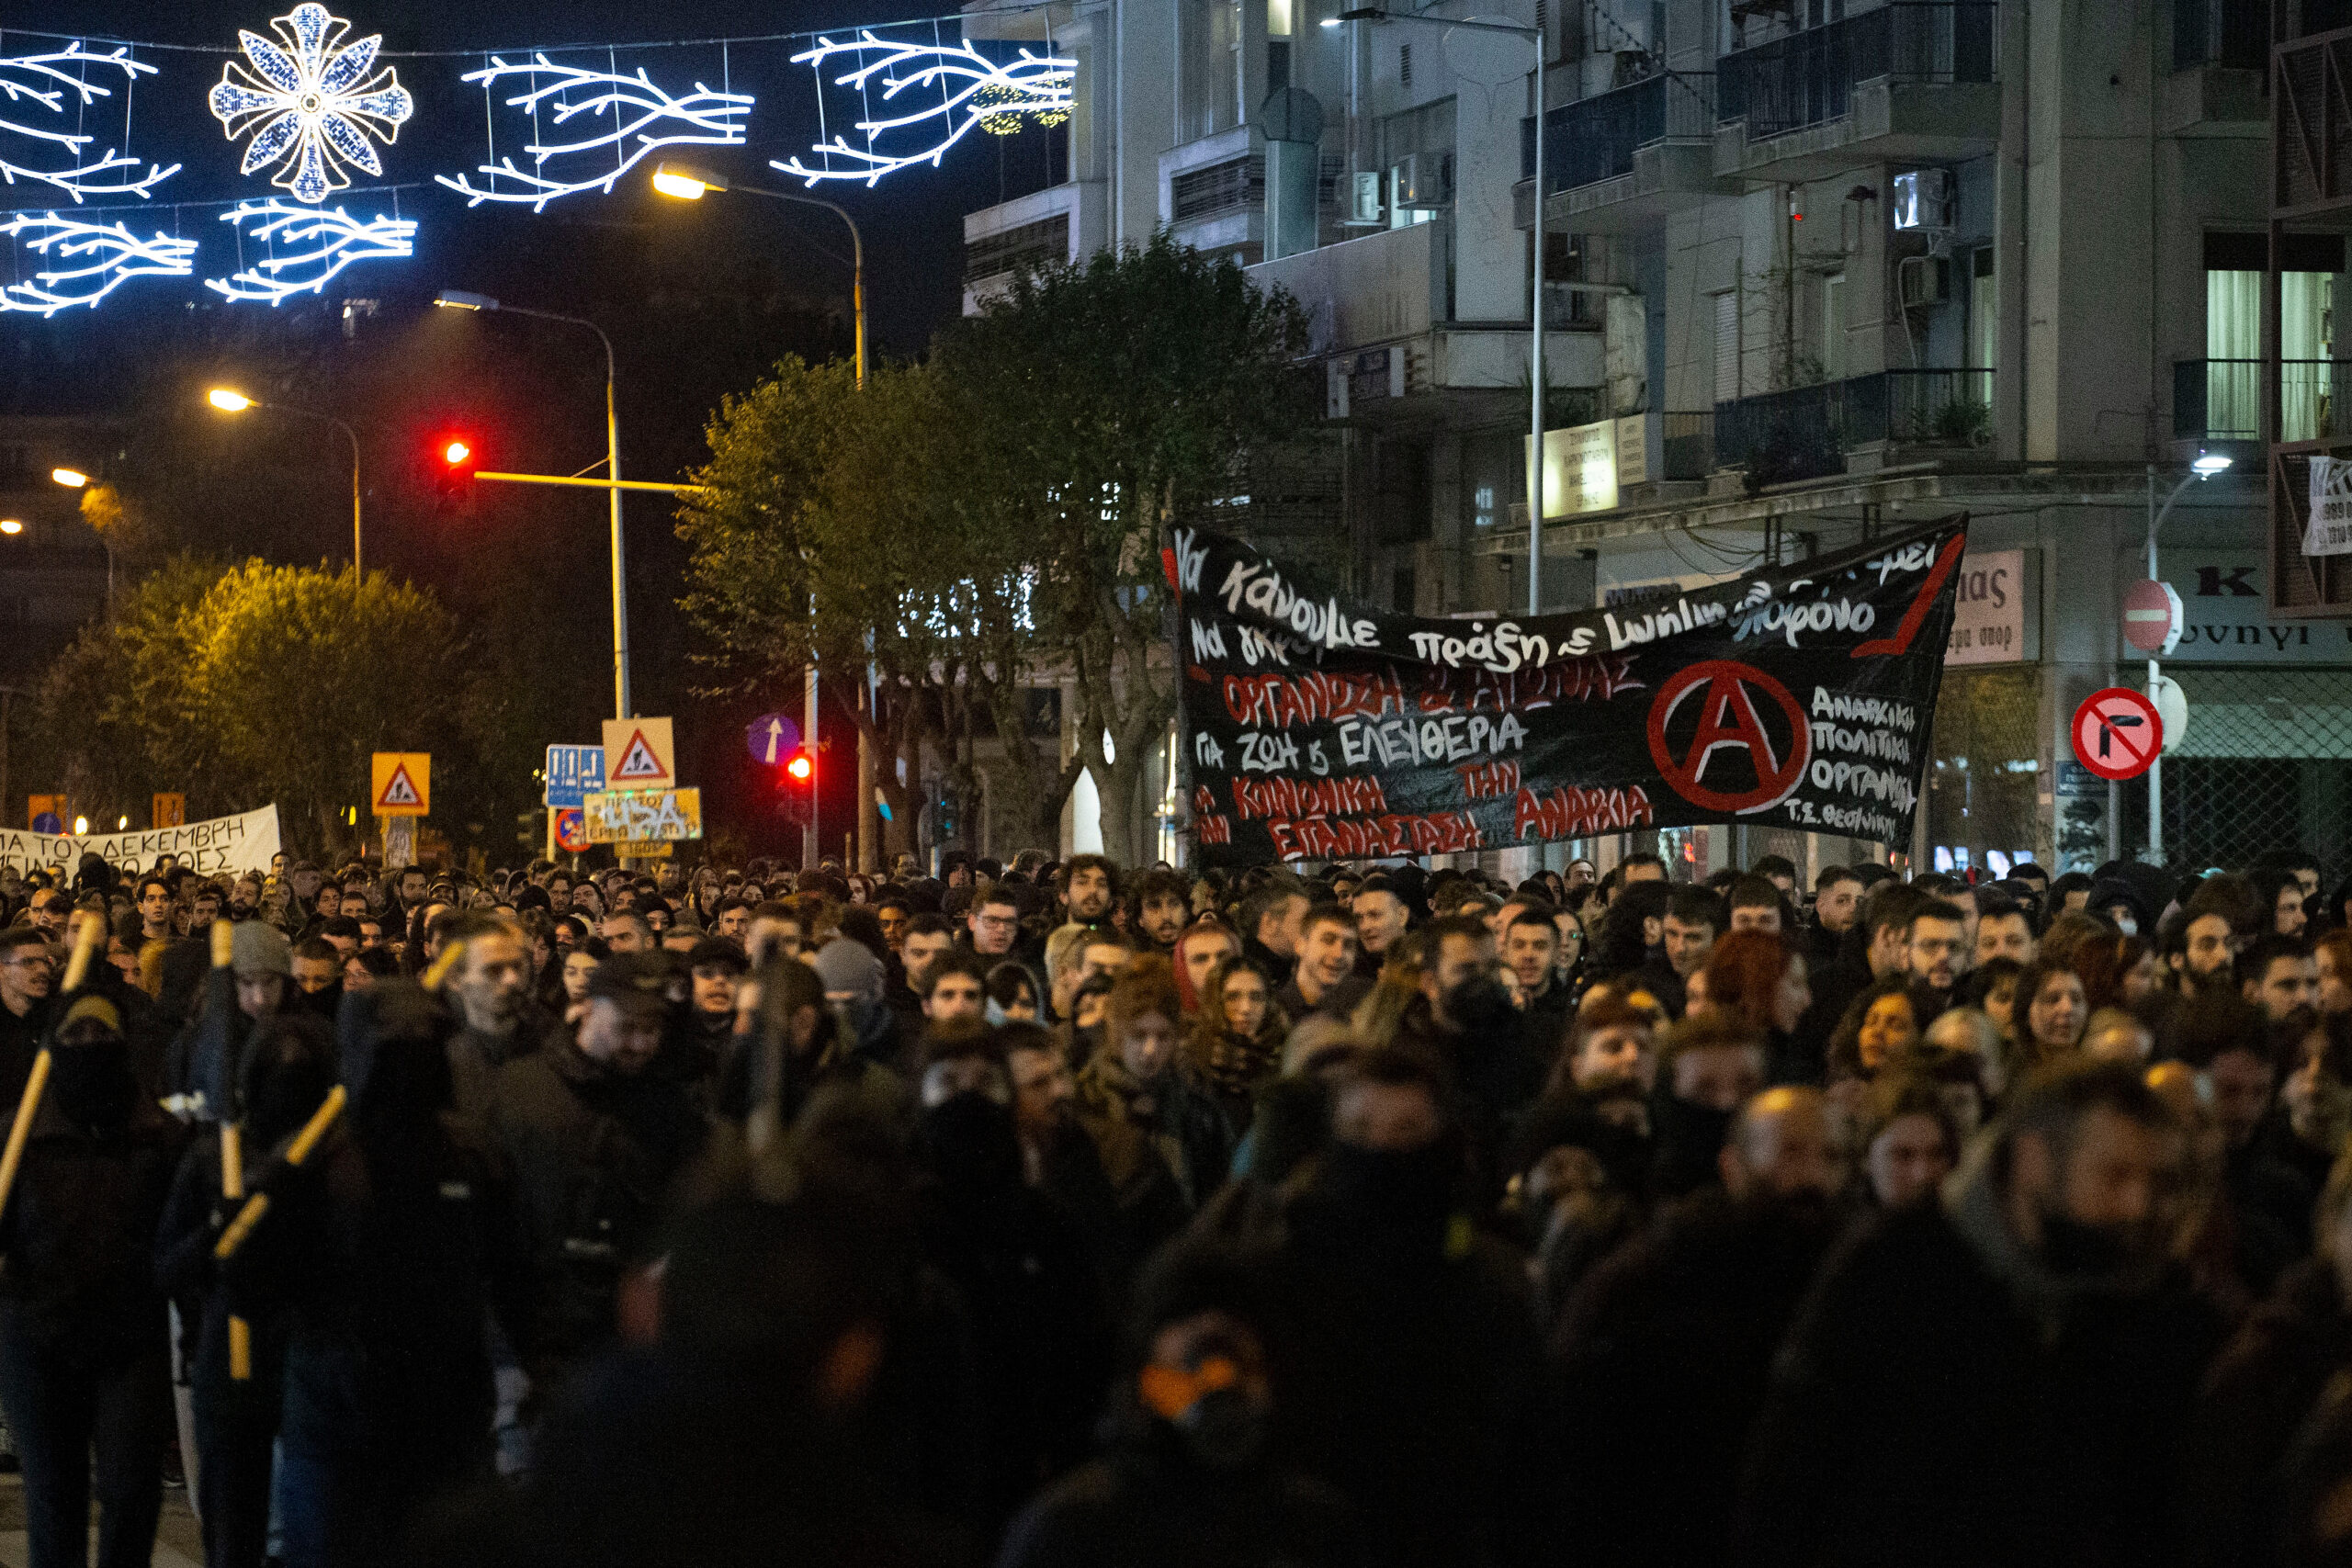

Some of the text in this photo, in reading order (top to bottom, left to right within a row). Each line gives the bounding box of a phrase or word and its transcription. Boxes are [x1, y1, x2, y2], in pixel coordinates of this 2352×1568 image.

[1340, 713, 1530, 769] ΕΛΕΥΘΕΡΙΑ
[33, 835, 91, 860] ΤΟΥ
[103, 817, 245, 859] ΔΕΚΕΜΒΡΗ
[1514, 784, 1655, 840] ΑΝΑΡΧΙΑ
